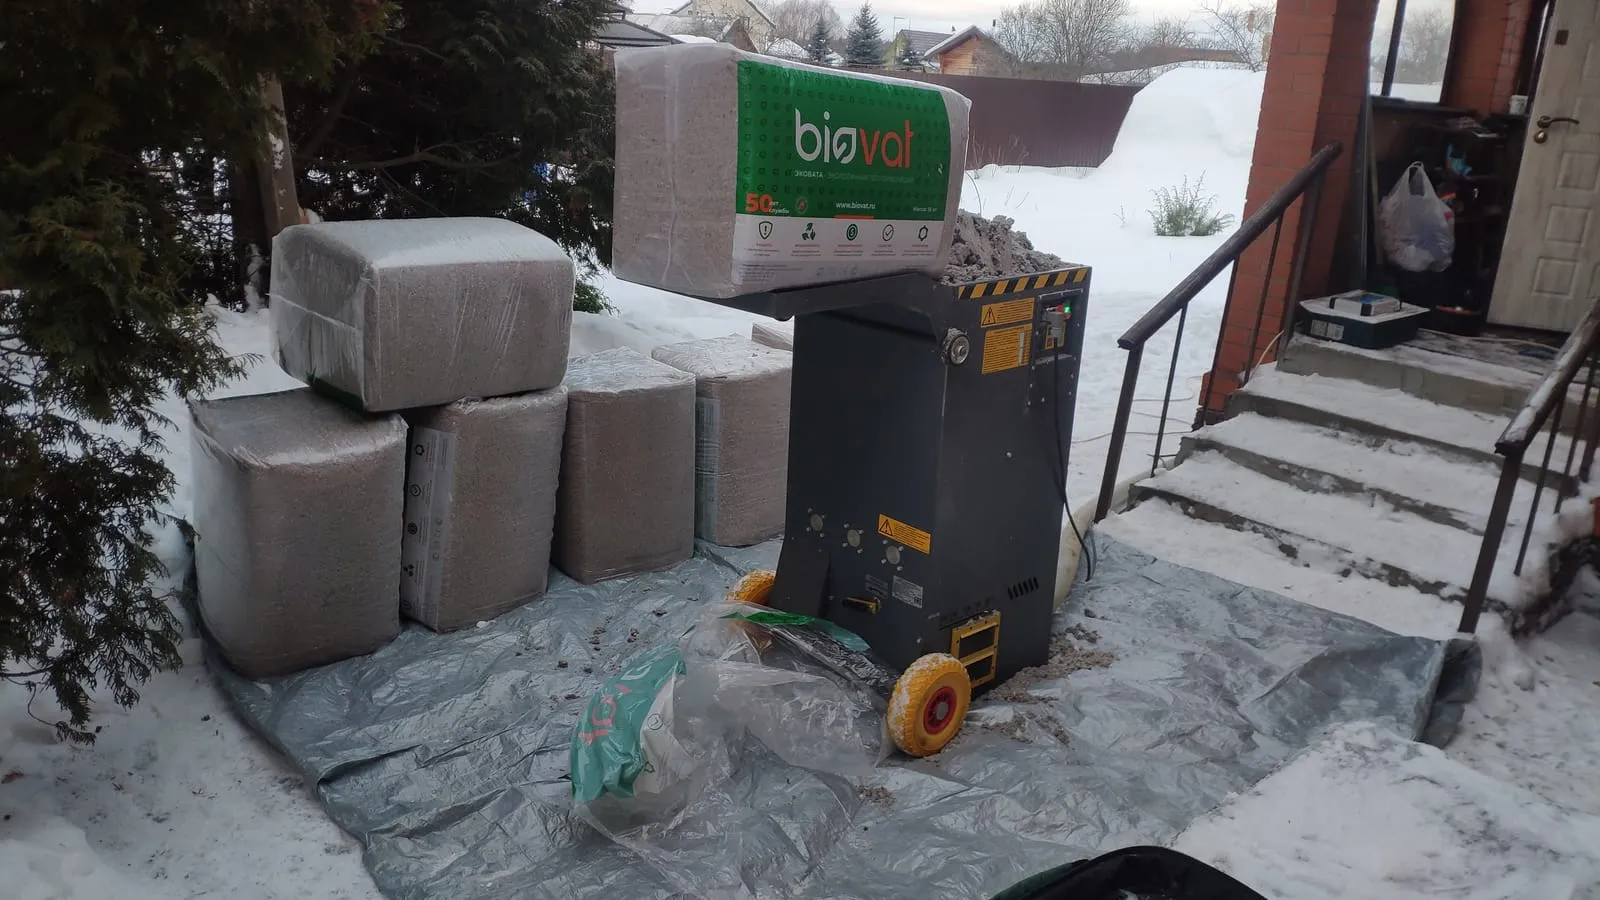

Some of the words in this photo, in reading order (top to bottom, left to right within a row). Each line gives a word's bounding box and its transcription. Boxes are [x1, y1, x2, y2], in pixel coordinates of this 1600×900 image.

[795, 108, 914, 168] biovat
[794, 170, 824, 179] ЭКОВАТА
[744, 193, 773, 213] 50
